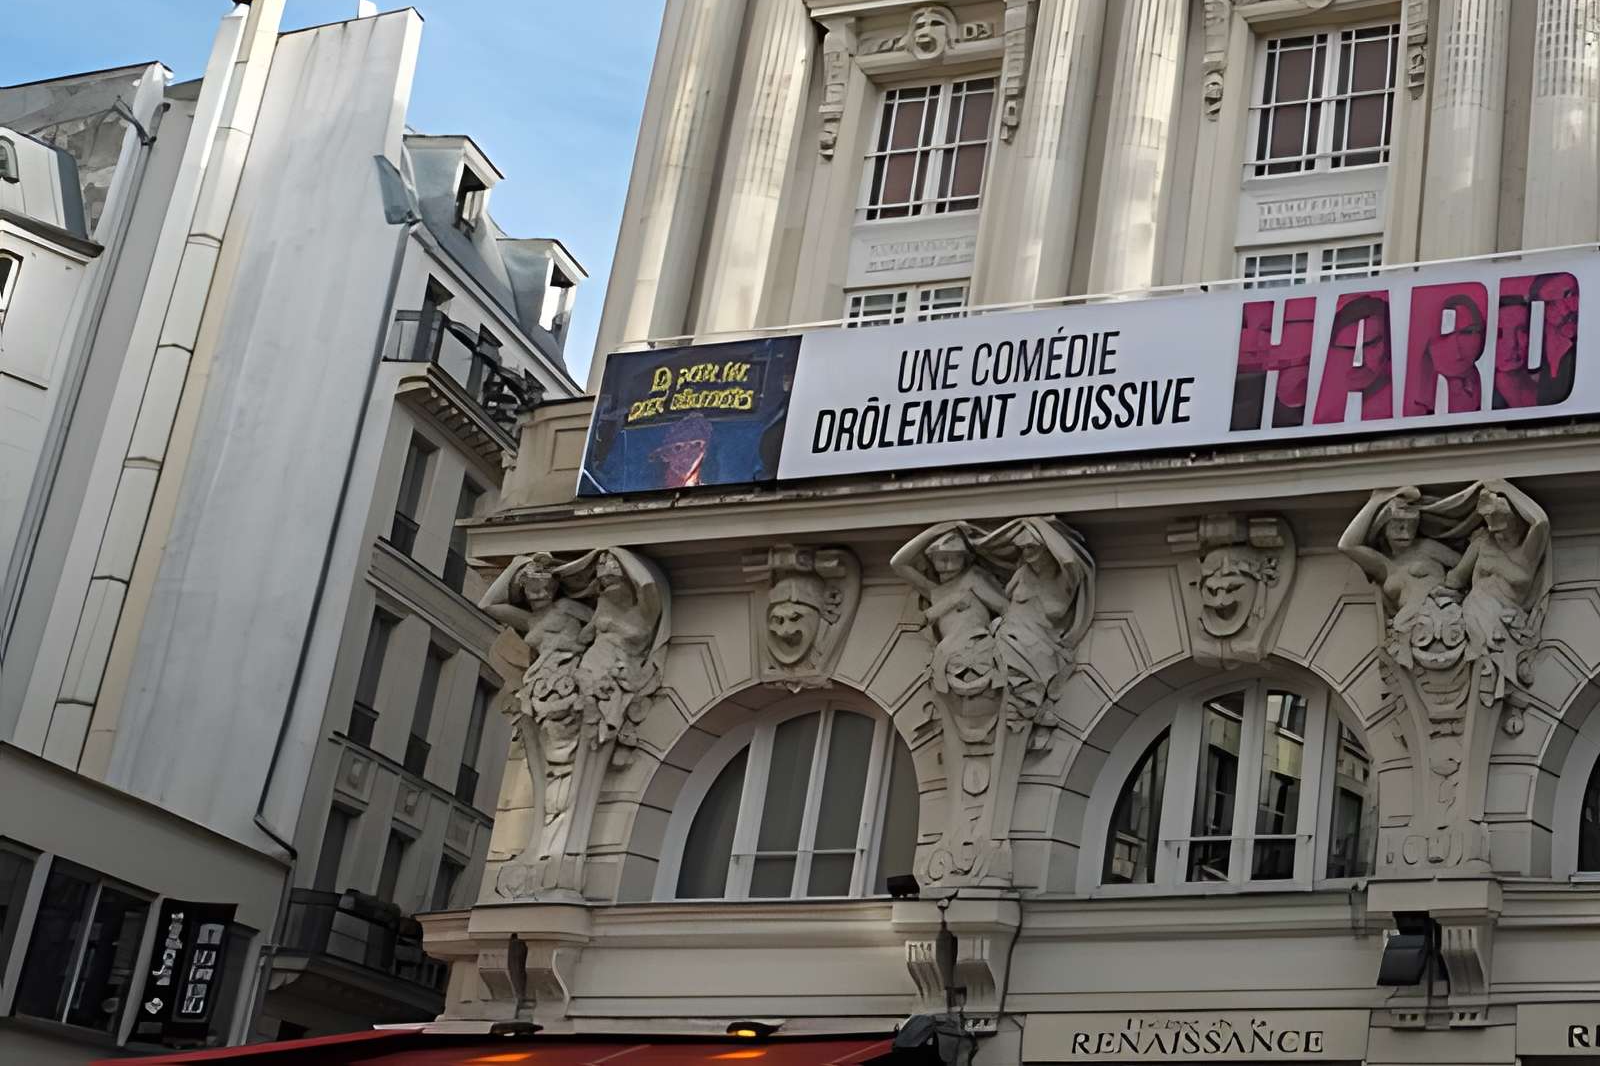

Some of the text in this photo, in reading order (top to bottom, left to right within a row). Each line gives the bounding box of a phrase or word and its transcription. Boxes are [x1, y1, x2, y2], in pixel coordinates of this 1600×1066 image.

[897, 326, 1121, 394] UNE COMÉDIE
[1228, 270, 1580, 432] HARD
[811, 392, 1017, 454] DRÔLEMENT
[1019, 377, 1195, 436] JOUISSIVE
[1071, 1029, 1324, 1055] RENAISSANCE
